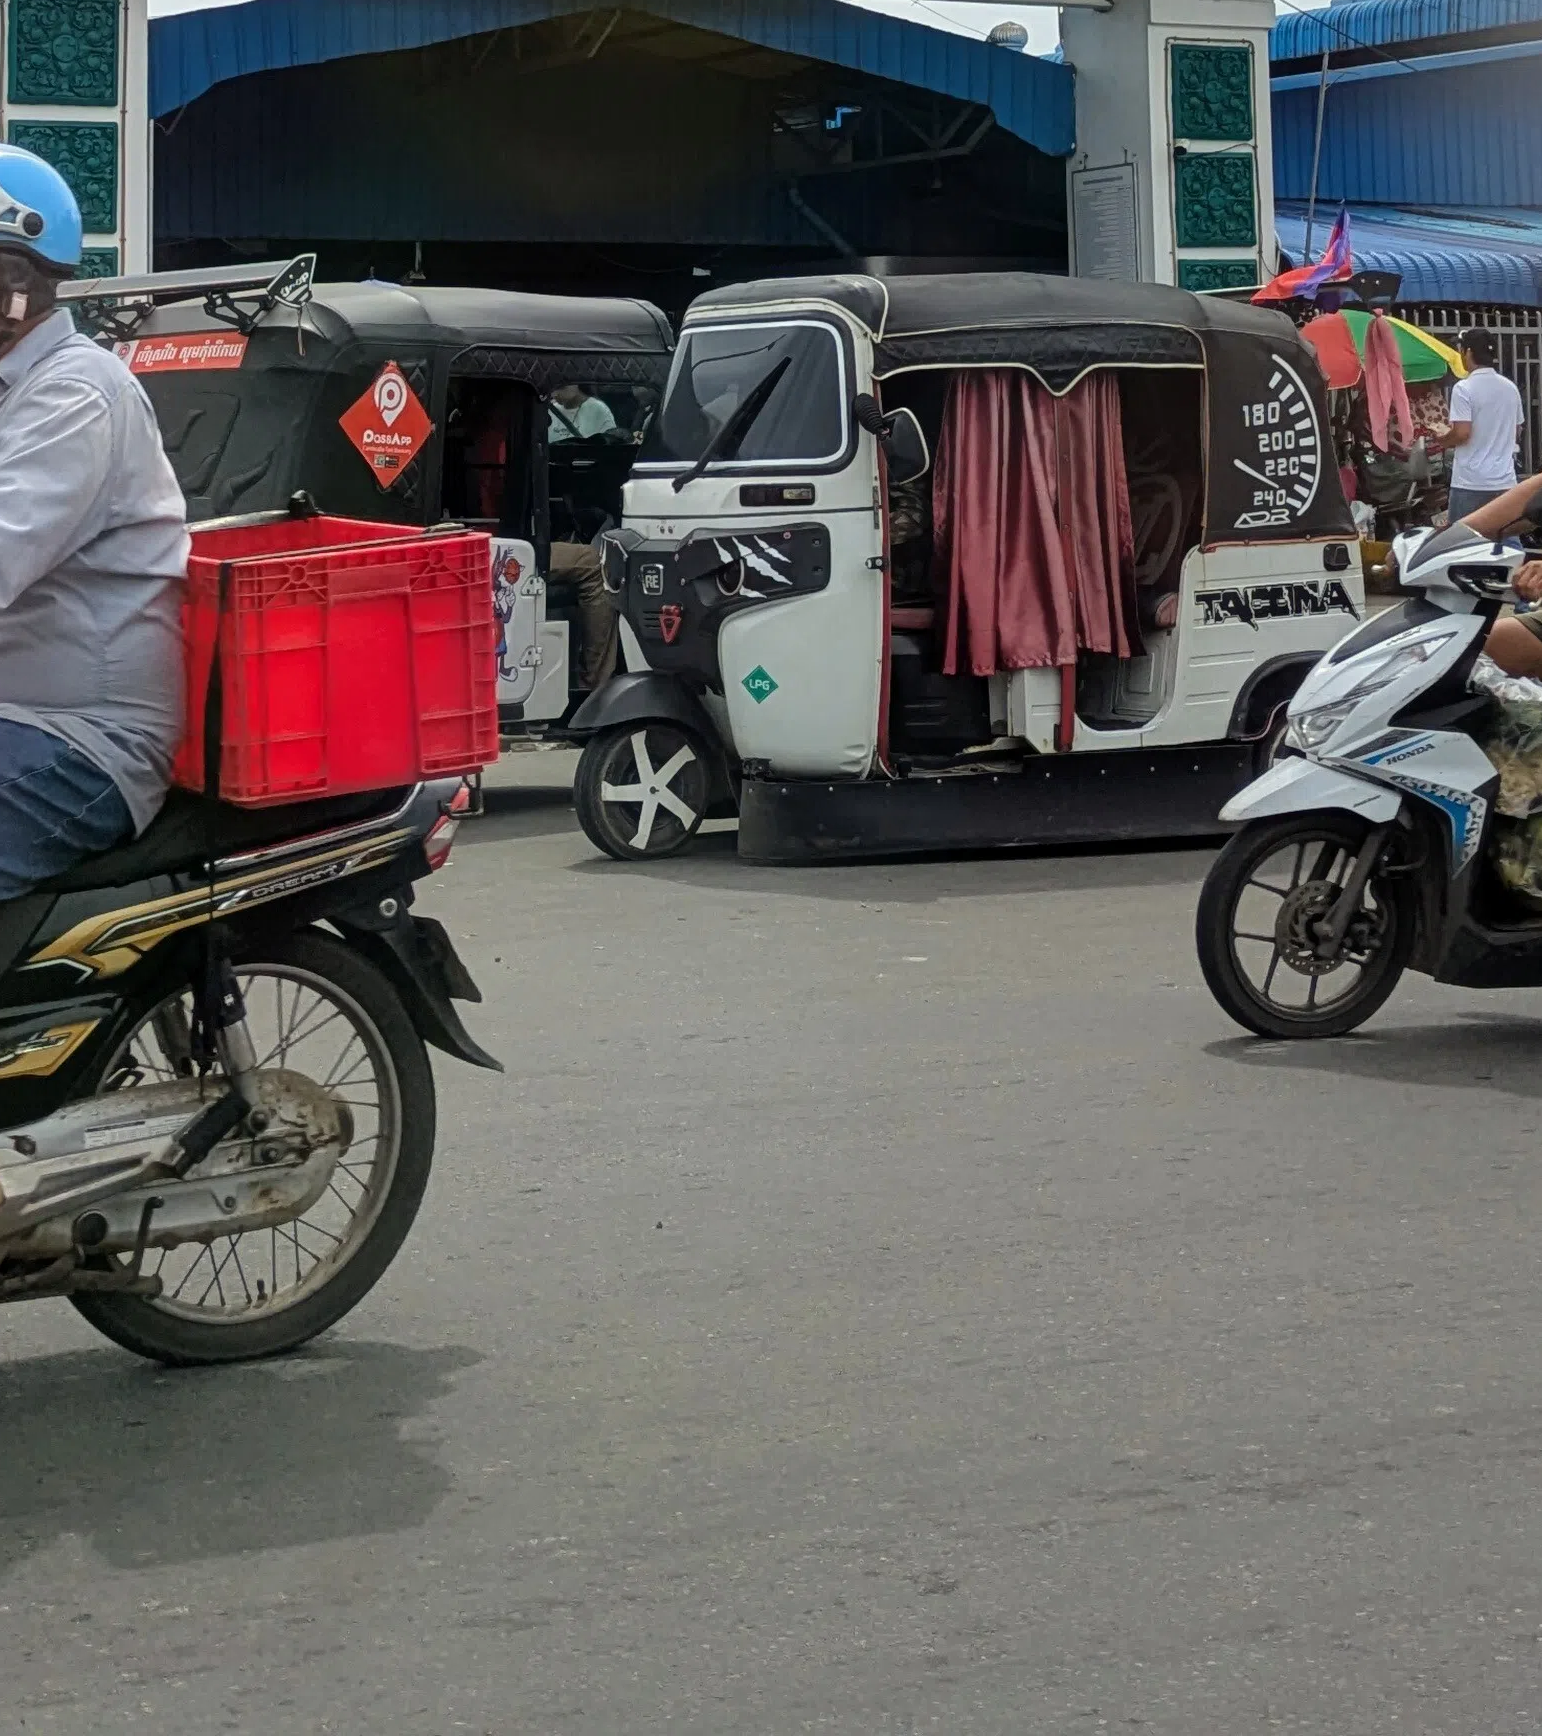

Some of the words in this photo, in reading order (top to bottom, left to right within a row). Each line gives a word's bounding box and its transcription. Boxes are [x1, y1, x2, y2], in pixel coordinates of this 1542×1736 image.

[1243, 401, 1280, 427] 180
[363, 429, 412, 445] PassApp
[1258, 430, 1294, 453] 200
[1265, 456, 1299, 477] 220
[1253, 489, 1286, 506] 240
[645, 574, 659, 588] RE
[1194, 579, 1360, 631] TACOMA
[749, 679, 770, 691] LPG
[1386, 743, 1436, 765] HONDA
[252, 865, 337, 897] DREAM
